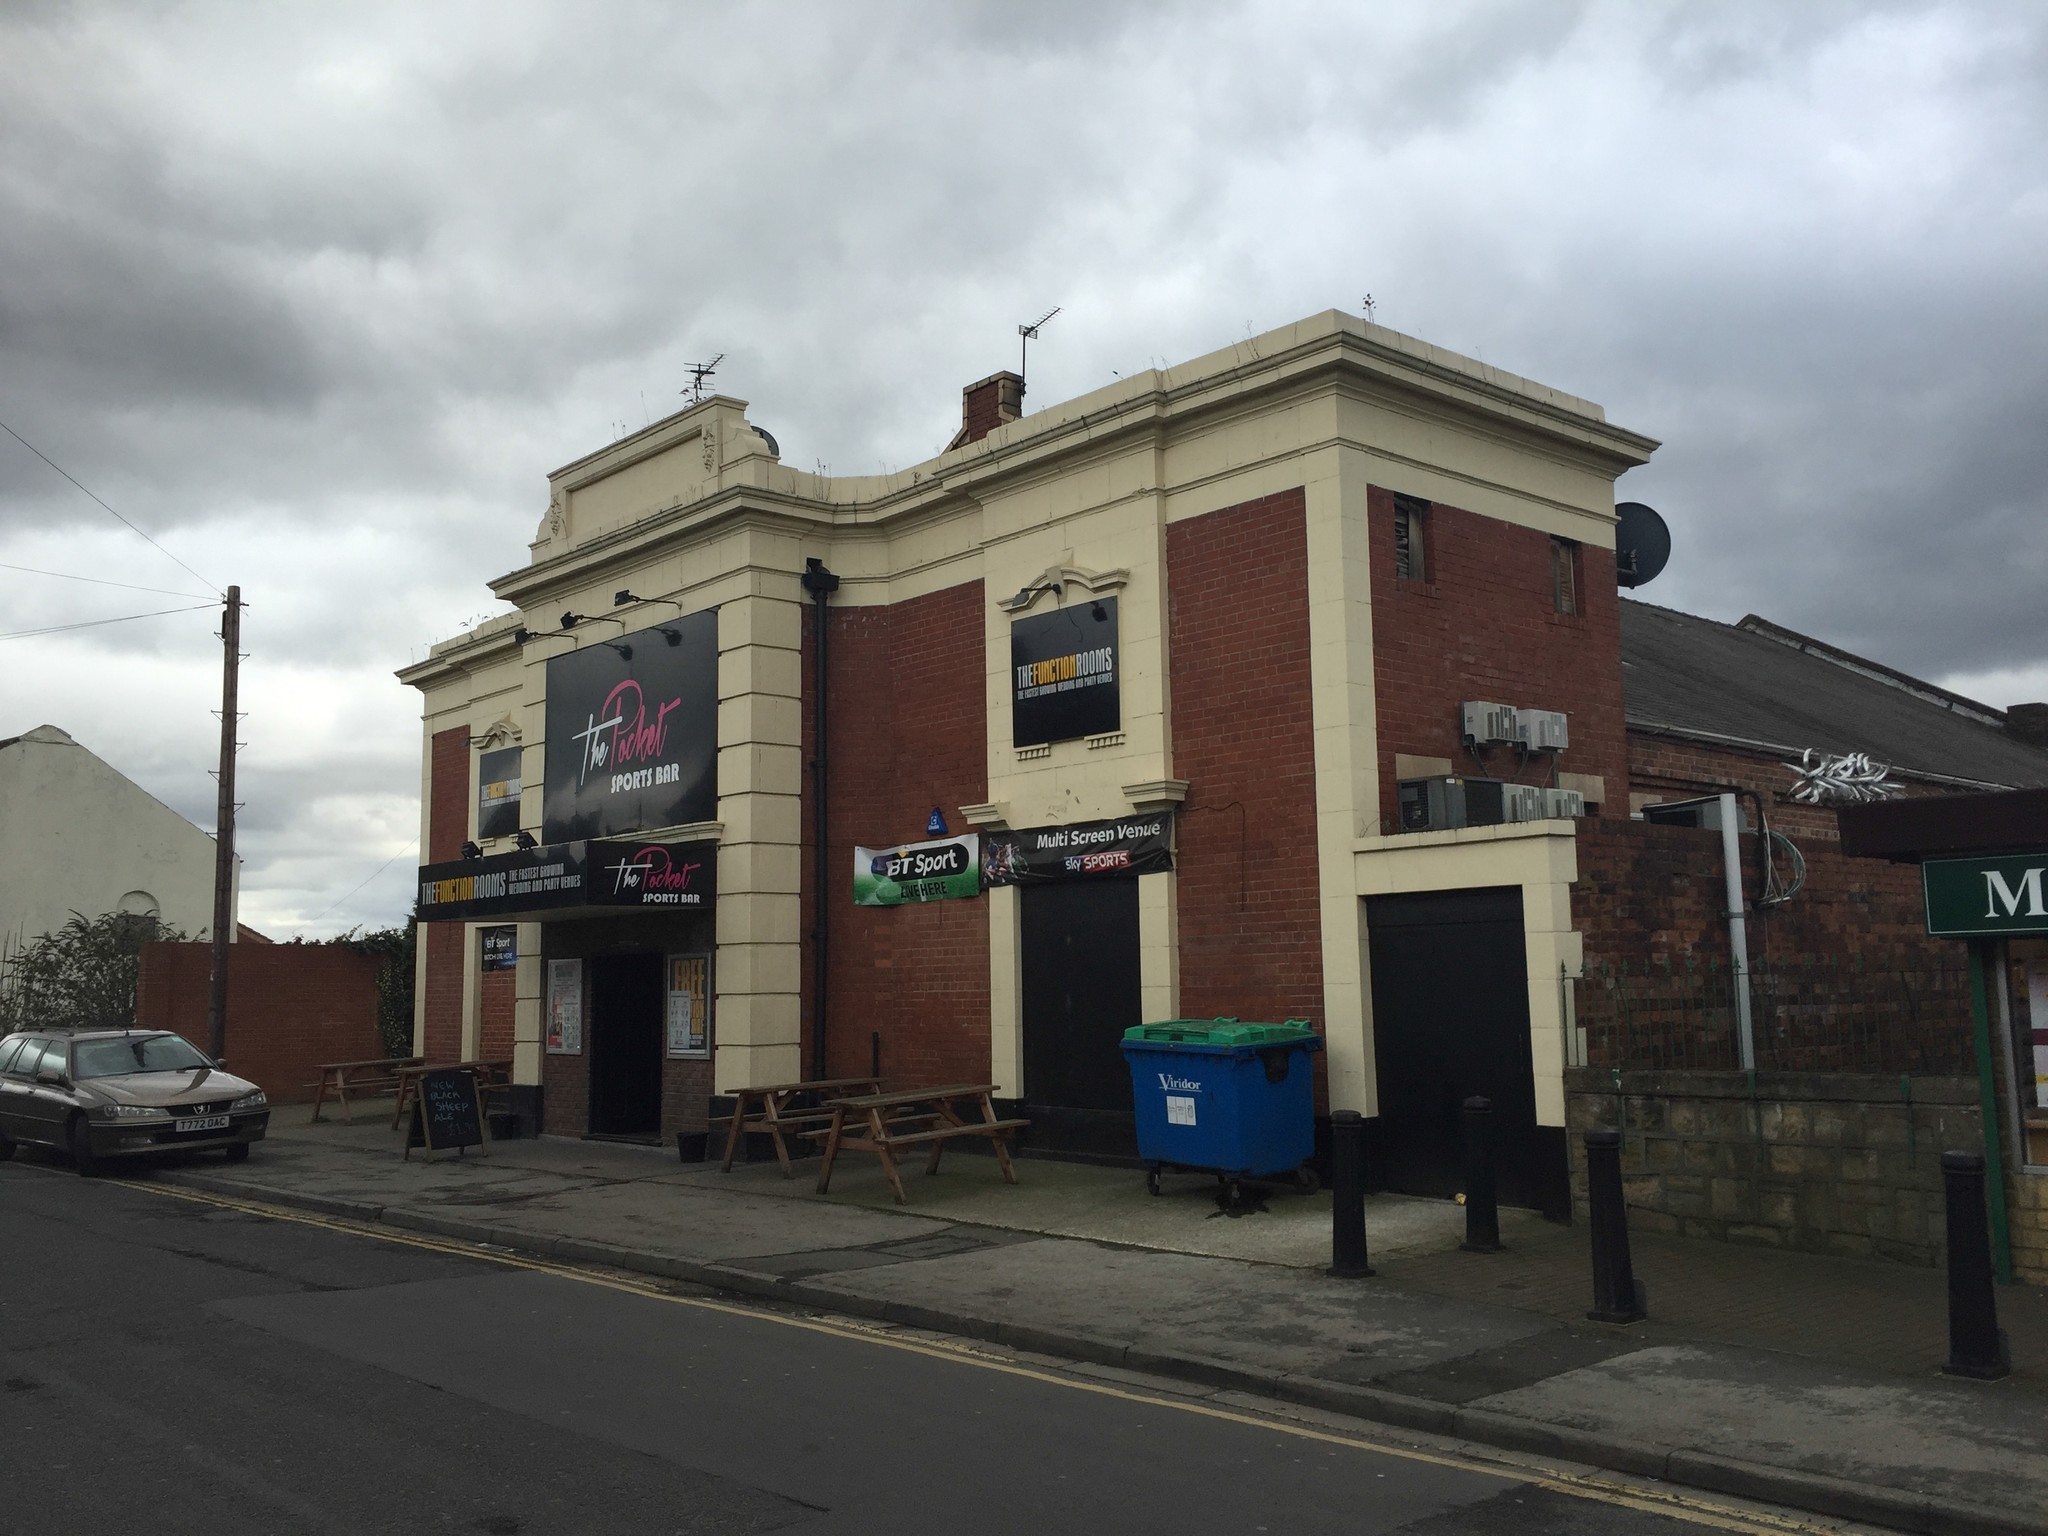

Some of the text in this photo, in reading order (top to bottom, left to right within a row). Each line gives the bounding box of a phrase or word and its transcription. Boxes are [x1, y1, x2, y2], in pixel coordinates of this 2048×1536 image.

[572, 679, 681, 786] The Pocket
[611, 763, 680, 794] SPORTS BAR
[1037, 823, 1160, 849] Multi Screen Venue
[509, 862, 564, 882] THE FASTEST GROWING
[604, 846, 701, 895] The Pocket
[886, 849, 958, 877] BT Sport
[1065, 853, 1129, 872] sky SPORTS
[509, 874, 581, 895] WEDDING AND PARTY VENUES
[920, 881, 948, 897] HERE
[642, 893, 701, 904] SPORTS BAR
[496, 937, 511, 950] Sport
[430, 1080, 455, 1090] NEW
[1158, 1073, 1201, 1092] Viridor
[435, 1101, 469, 1112] SHEEP
[180, 1117, 226, 1130] T772 OAC
[434, 1113, 454, 1122] ALE
